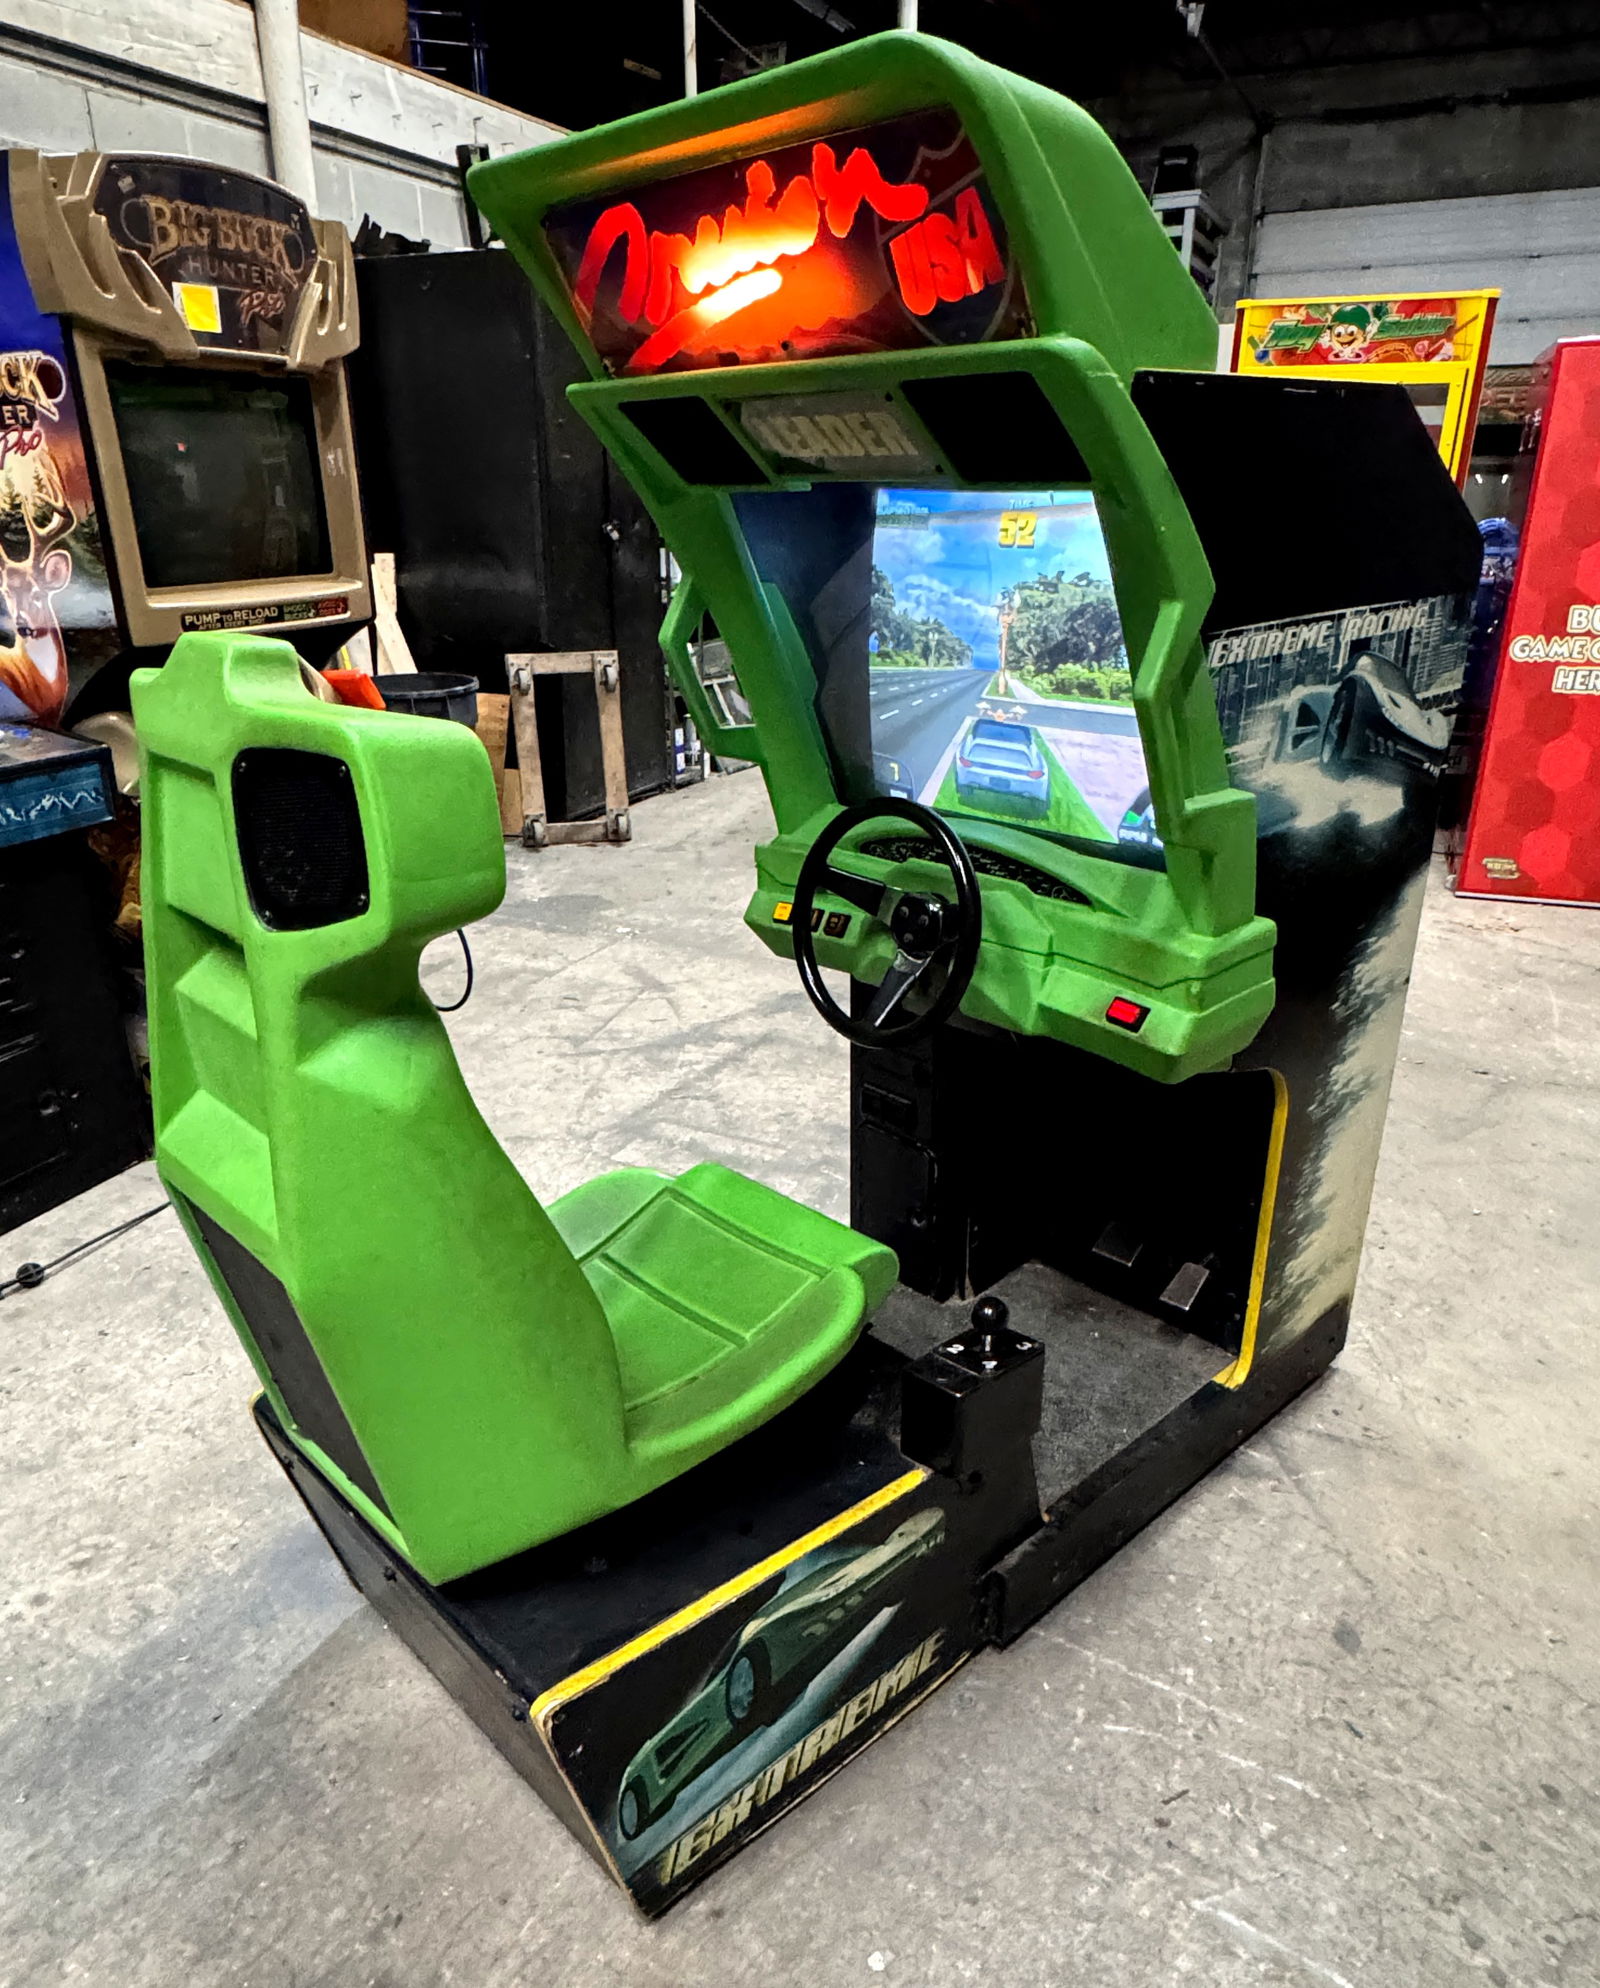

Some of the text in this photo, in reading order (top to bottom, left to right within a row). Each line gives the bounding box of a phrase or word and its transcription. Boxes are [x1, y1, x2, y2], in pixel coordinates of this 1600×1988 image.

[140, 194, 299, 290] BIG BUCK
[889, 187, 1006, 316] USA
[186, 254, 276, 288] HUNTER
[751, 411, 920, 458] LEADER
[998, 511, 1038, 549] 52
[184, 612, 221, 627] PUMP
[234, 606, 279, 620] RELOAD
[1208, 605, 1430, 668] EXTREME RACING
[1509, 634, 1591, 663] GAME
[658, 1627, 946, 1886] EXTREME
